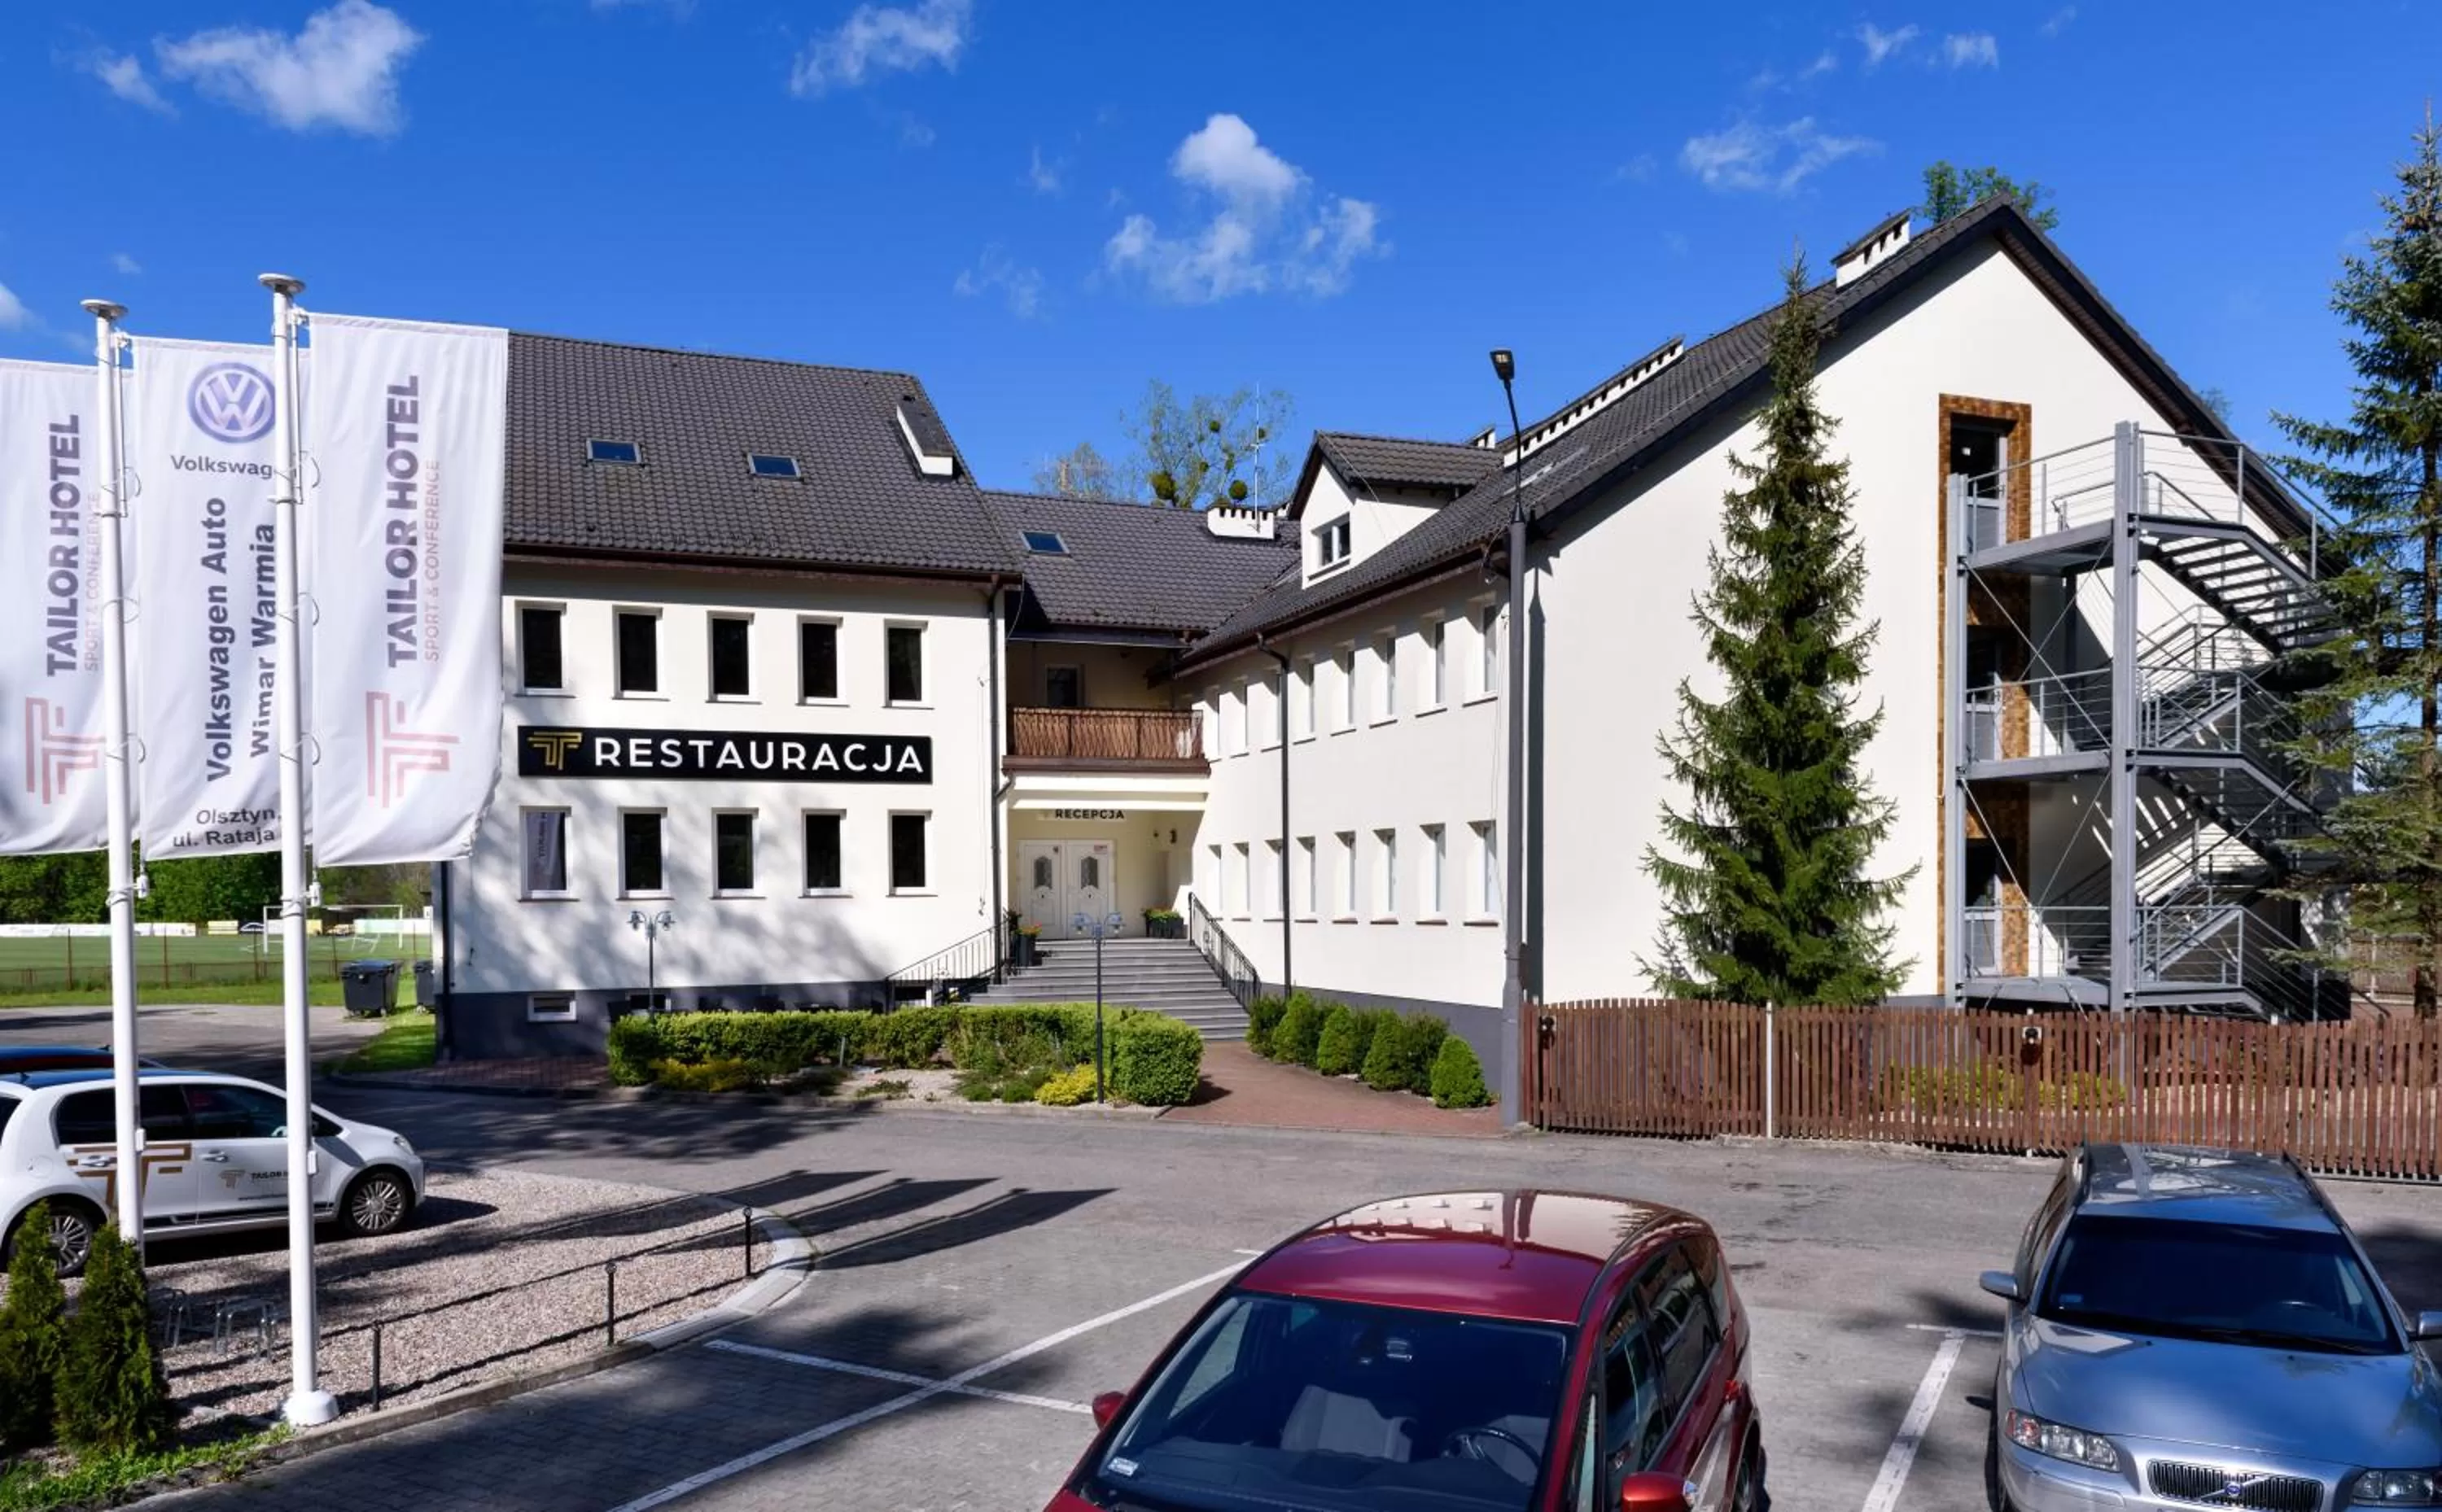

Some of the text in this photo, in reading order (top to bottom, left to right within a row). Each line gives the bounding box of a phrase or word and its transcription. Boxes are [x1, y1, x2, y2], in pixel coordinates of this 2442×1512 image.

[170, 454, 274, 479] Volkswag
[386, 375, 418, 668] TAILOR HOTEL
[46, 414, 81, 677] TAILOR HOTEL
[424, 460, 440, 662] SPORT & CONFERENCE
[84, 620, 98, 672] SPORT
[201, 497, 235, 782] Volkswagen Auto
[249, 523, 277, 758] Wimar Warmia
[595, 737, 924, 773] RESTAURACJA
[1055, 809, 1124, 819] RECEPCJA
[173, 827, 274, 847] ul. Rataja
